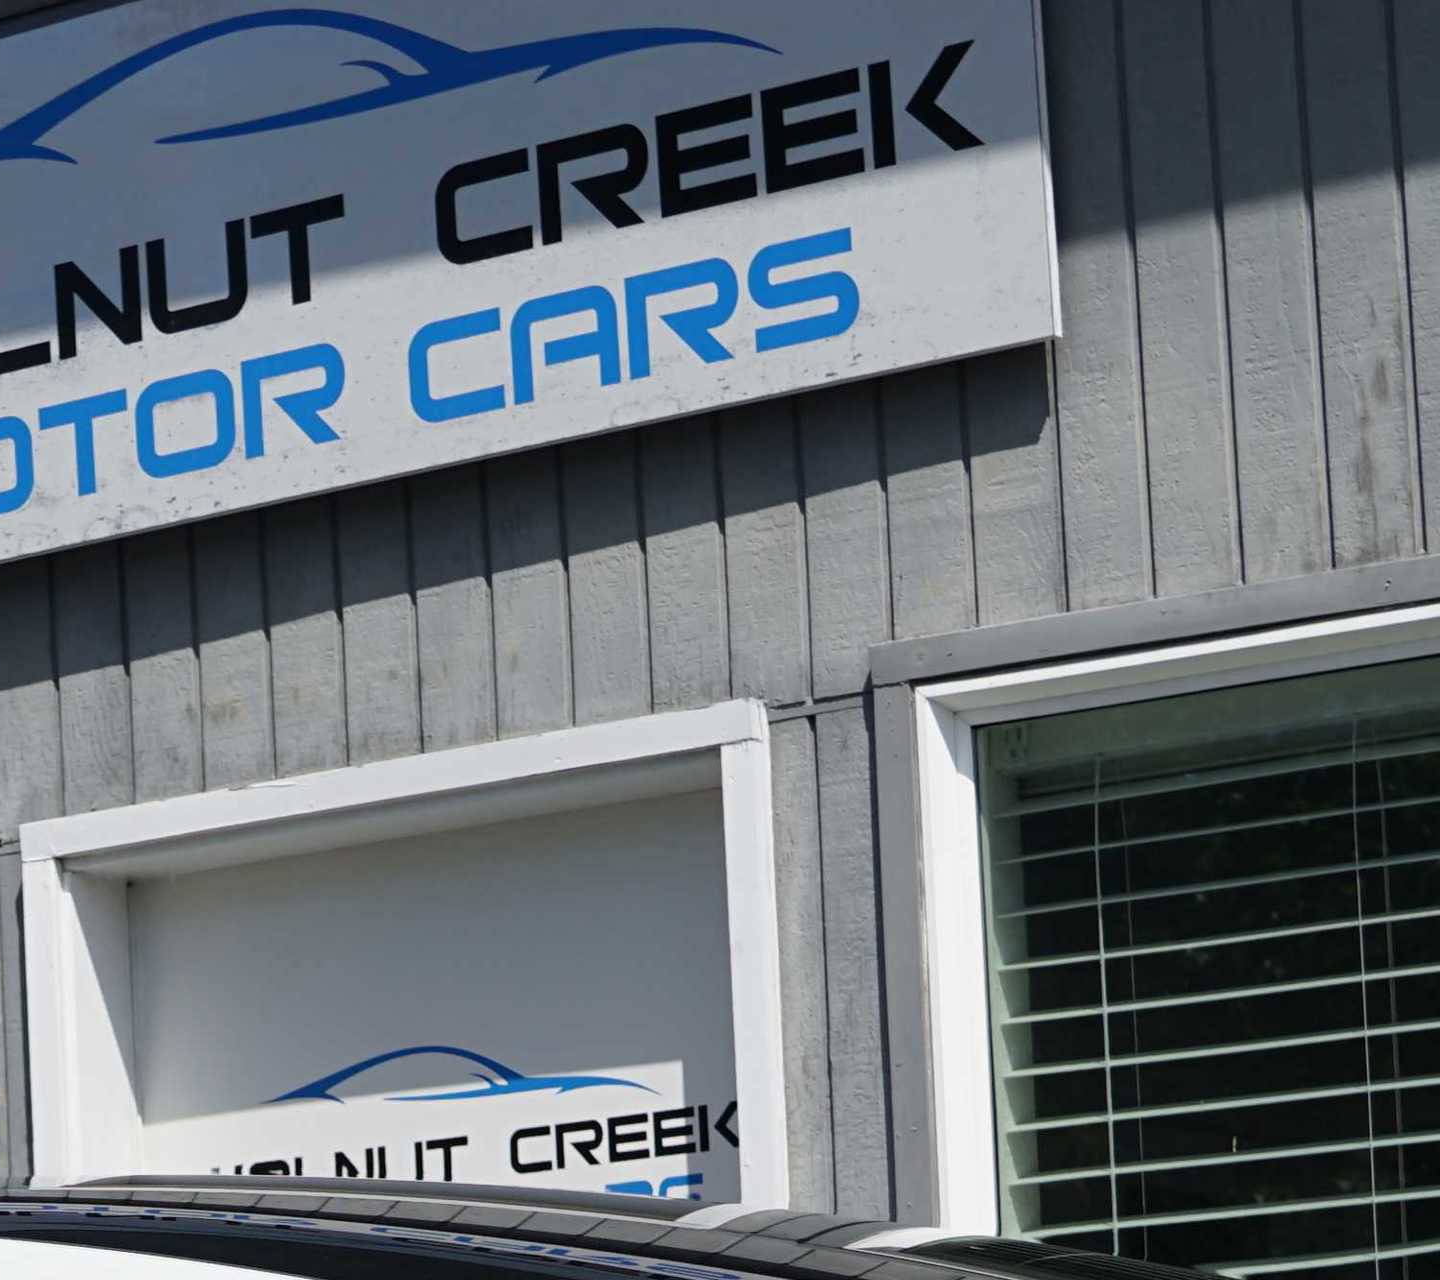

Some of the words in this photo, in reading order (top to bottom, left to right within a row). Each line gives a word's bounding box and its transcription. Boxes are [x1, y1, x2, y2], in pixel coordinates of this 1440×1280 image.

[434, 39, 985, 265] CREEK
[408, 228, 860, 423] CARS
[510, 1100, 740, 1174] CREEK
